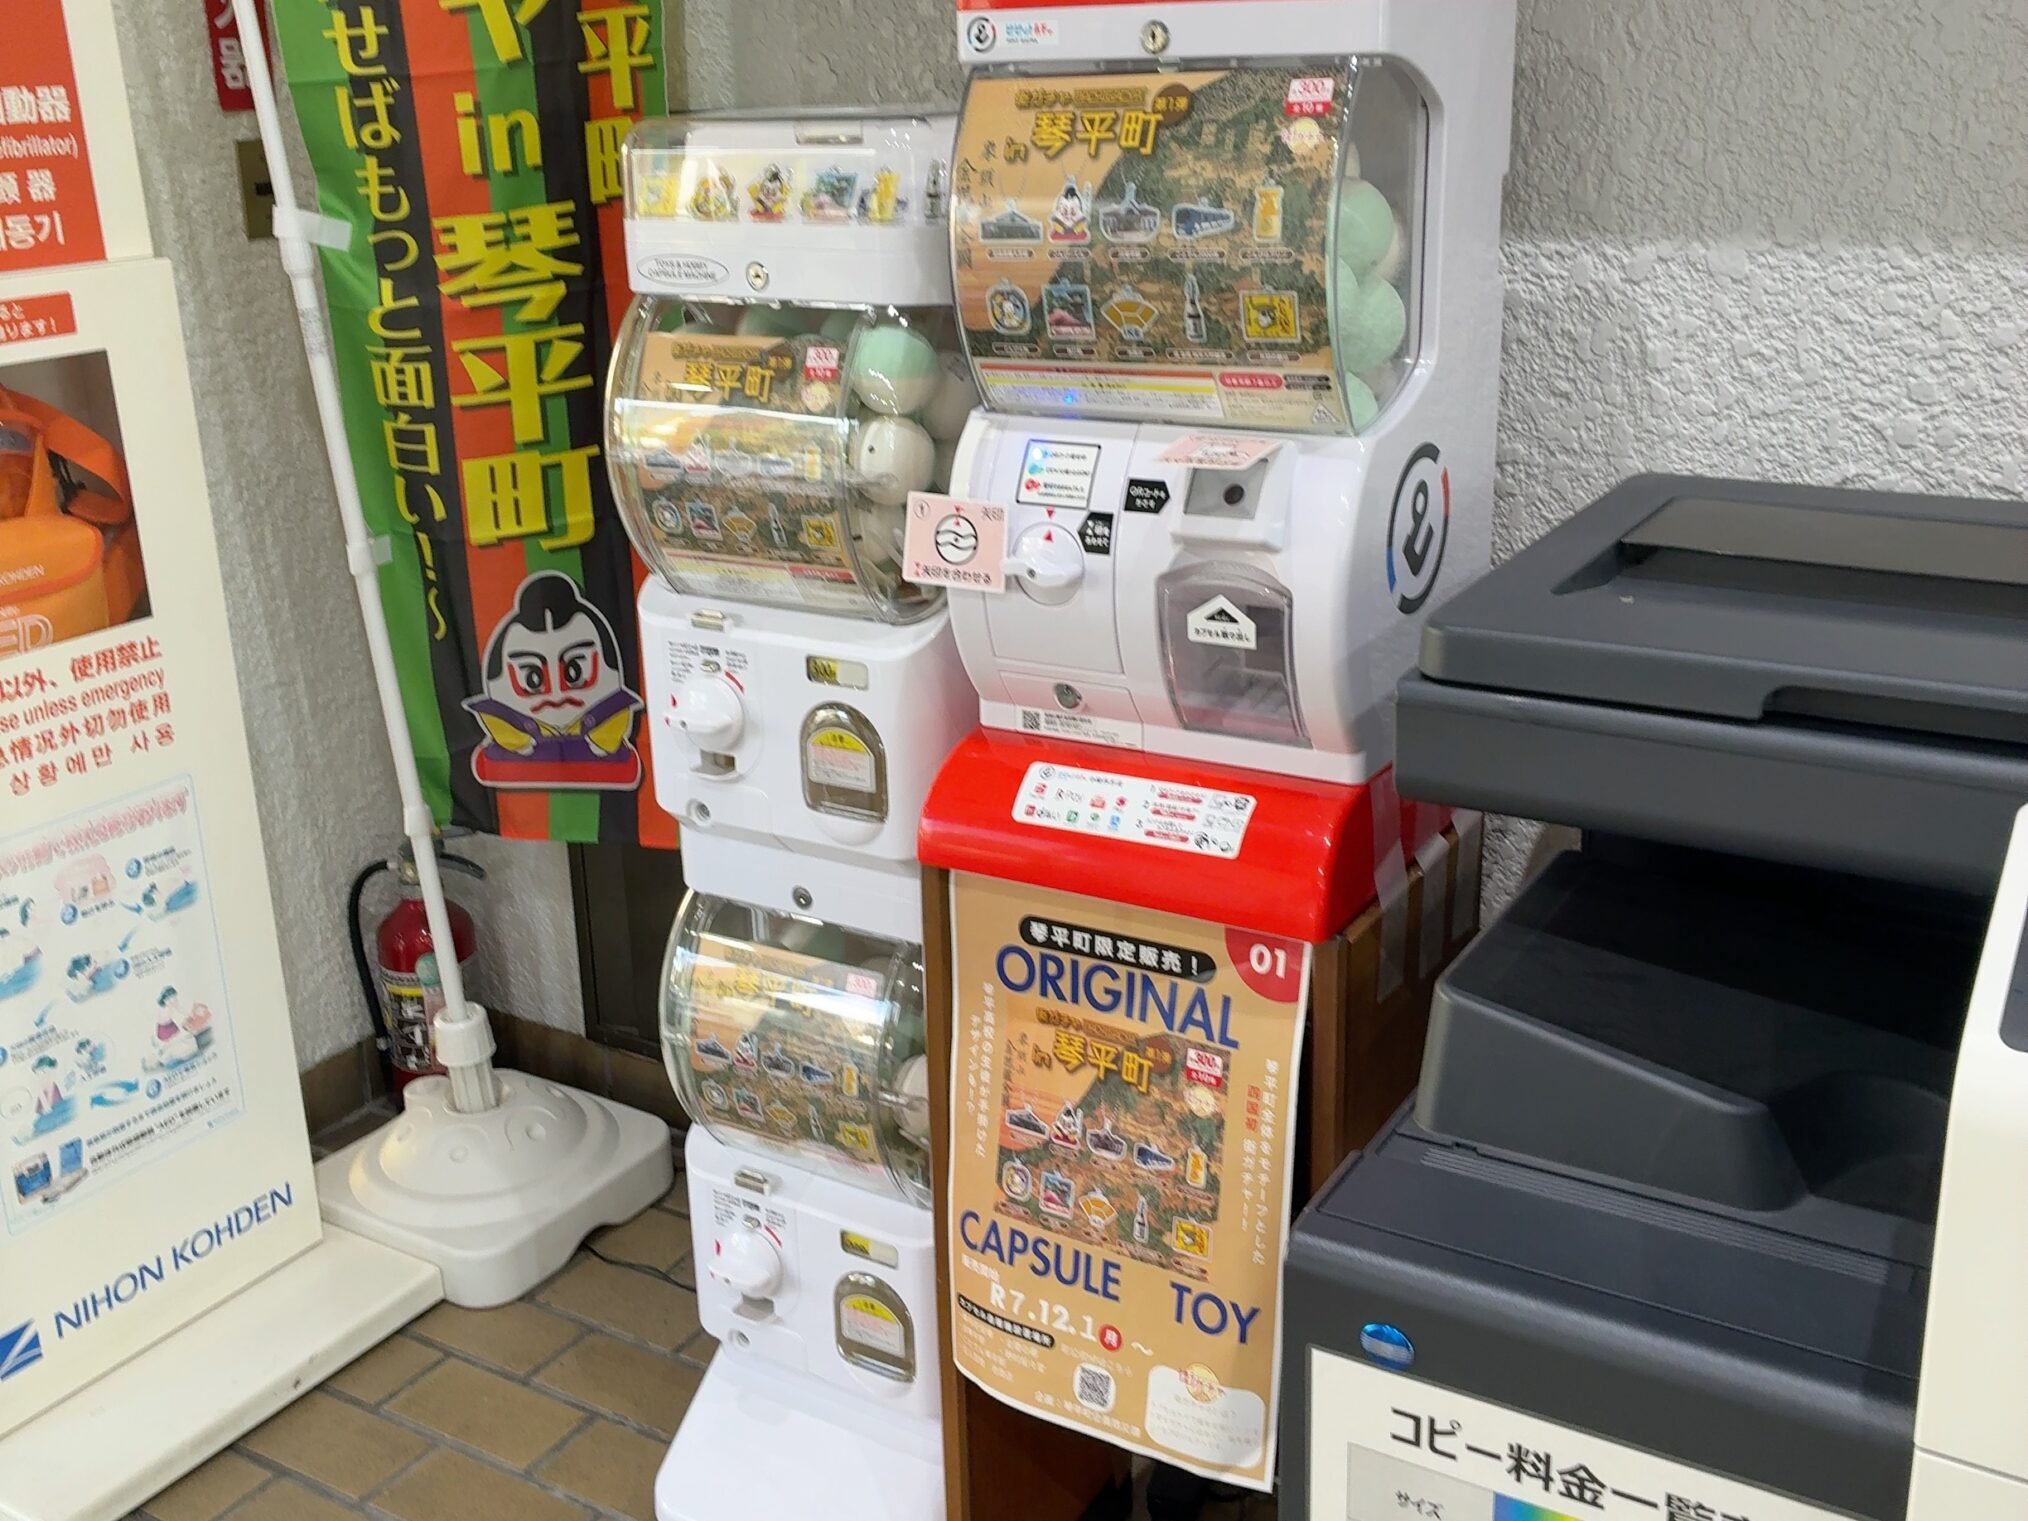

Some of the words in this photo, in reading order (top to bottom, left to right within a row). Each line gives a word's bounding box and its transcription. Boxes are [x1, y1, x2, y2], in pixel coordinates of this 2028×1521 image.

[0, 84, 71, 125] 動器
[453, 92, 543, 177] in
[1030, 110, 1164, 158] 琴平町
[431, 199, 601, 552] 琴平町
[23, 694, 78, 726] unless
[80, 667, 165, 704] emergency
[1028, 920, 1200, 976] 琴平町限定販売!
[1249, 943, 1288, 979] 01
[996, 944, 1240, 1049] ORIGINAL
[1053, 1028, 1154, 1094] 琴平町
[54, 1254, 165, 1339] NIHON
[171, 1181, 293, 1272] KOHDEN
[960, 1209, 1122, 1303] CAPSULE
[988, 1280, 1097, 1342] R7.12.1
[1169, 1280, 1261, 1344] TOY
[1390, 1406, 1752, 1521] コピー料金一覧
